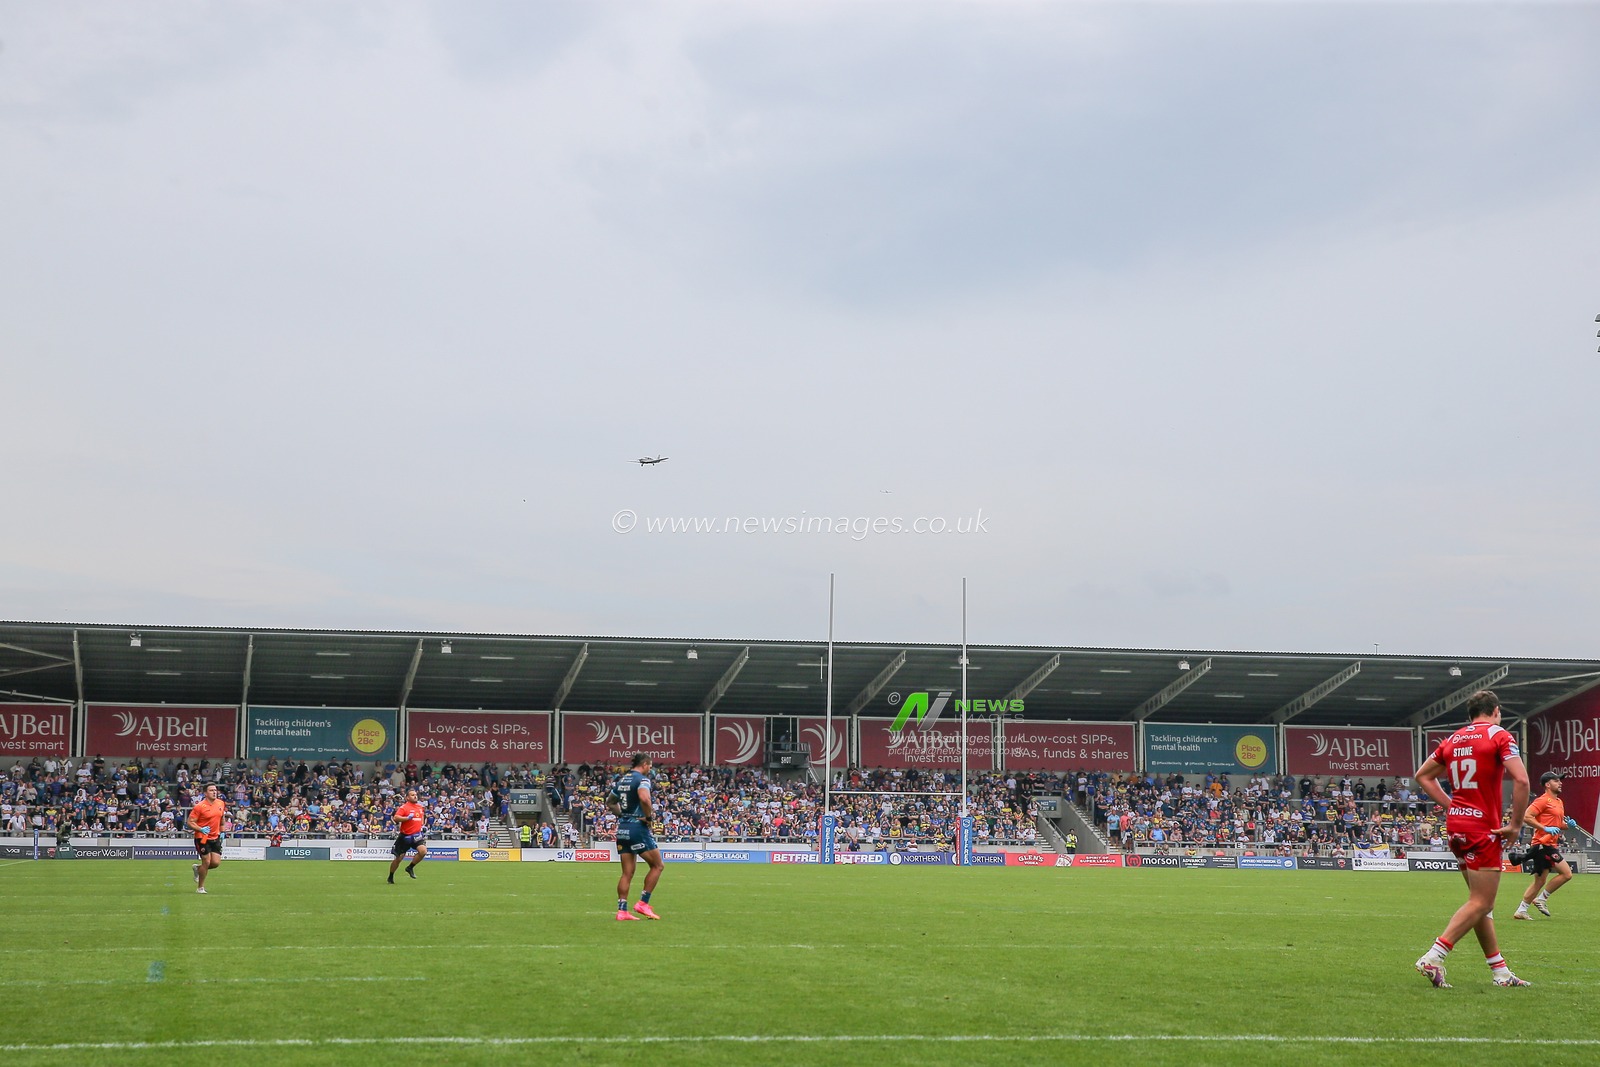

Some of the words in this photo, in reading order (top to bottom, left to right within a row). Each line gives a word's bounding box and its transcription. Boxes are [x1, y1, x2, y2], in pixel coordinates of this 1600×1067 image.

[255, 718, 290, 728] Tackling
[291, 719, 332, 728] children's
[136, 715, 208, 741] AJBell
[255, 728, 284, 736] mental
[428, 723, 488, 734] Low-cost
[492, 724, 531, 735] SIPPs,
[357, 729, 380, 737] Place
[608, 725, 676, 749] AJBell
[357, 737, 374, 745] 2Be
[415, 738, 447, 750] ISAs,
[450, 738, 486, 750] funds
[489, 739, 499, 750] &
[502, 739, 544, 750] shares
[1022, 734, 1078, 744] Low-cost
[1081, 734, 1117, 746] SIPPs,
[1150, 735, 1181, 744] Tackling
[1182, 735, 1218, 744] children's
[0, 741, 26, 750] vest
[29, 742, 64, 750] smart
[136, 741, 171, 751] Invest
[174, 742, 208, 752] smart
[1151, 743, 1177, 751] mental
[1177, 744, 1201, 752] health
[1241, 744, 1261, 752] Place
[1328, 737, 1390, 761] AJBell
[1044, 748, 1076, 759] funds
[1079, 749, 1088, 759] &
[1091, 749, 1129, 759] shares
[1241, 752, 1257, 760] 2Be
[1453, 746, 1473, 757] STONE
[904, 754, 935, 763] Invest
[1329, 760, 1359, 770] Invest
[1361, 761, 1390, 771] smart
[1450, 758, 1479, 790] 12
[557, 850, 574, 860] sky
[576, 851, 609, 860] sports
[903, 855, 941, 863] NORTHERN
[972, 855, 1003, 863] ORTHERN
[1018, 854, 1044, 863] GLEN'S
[1142, 857, 1178, 865] morson
[1415, 861, 1459, 870] ARGYLE
